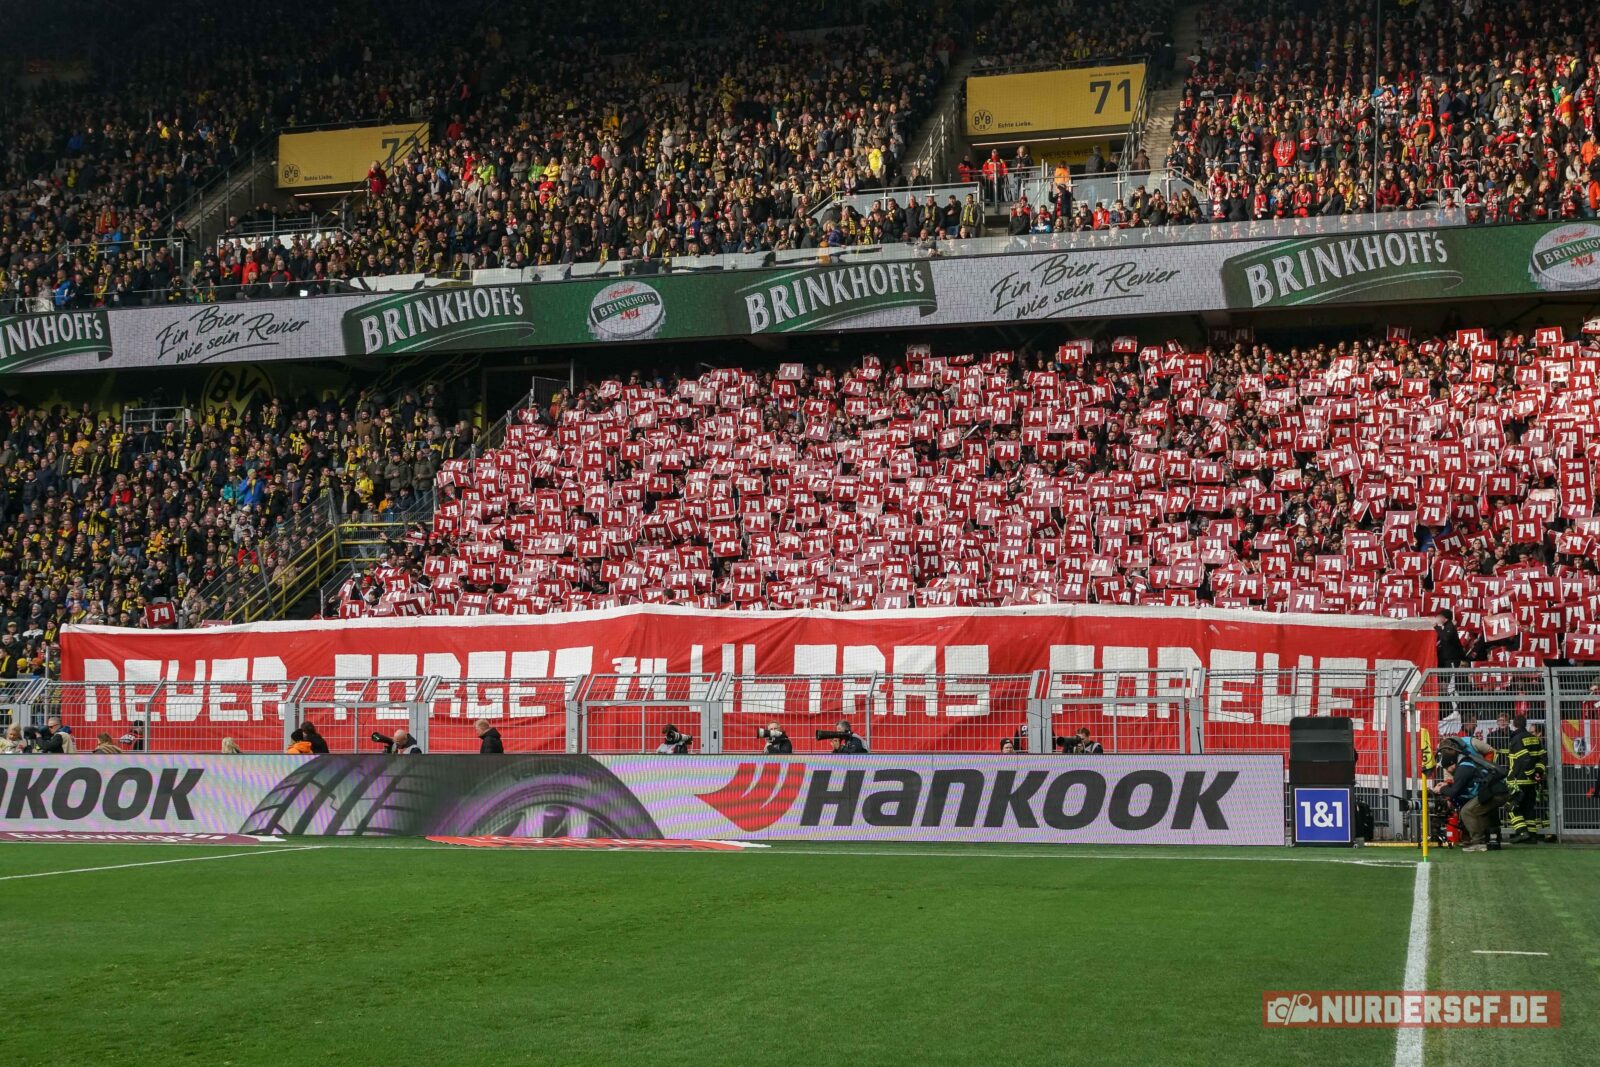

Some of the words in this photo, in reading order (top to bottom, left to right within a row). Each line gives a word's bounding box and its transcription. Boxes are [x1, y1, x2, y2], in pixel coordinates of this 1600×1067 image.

[1089, 79, 1131, 114] 71
[990, 272, 1031, 314] Ein
[1031, 253, 1101, 287] Bier
[1017, 296, 1049, 319] wie
[1053, 279, 1094, 304] sein
[1097, 261, 1180, 294] Revier
[156, 321, 190, 361] Ein
[195, 304, 244, 335] Bier
[176, 343, 204, 363] wie
[206, 328, 240, 351] sein
[242, 313, 311, 344] Revier
[1462, 333, 1478, 345] 74
[1541, 331, 1557, 343] 74
[1065, 349, 1078, 360] 74
[1558, 345, 1574, 358] 74
[1579, 361, 1596, 375] 74
[1040, 376, 1053, 386] 74
[1521, 369, 1537, 381] 74
[849, 382, 862, 393] 74
[1408, 382, 1423, 393] 74
[1574, 376, 1590, 388] 74
[625, 388, 638, 401] 74
[778, 384, 791, 395] 74
[1040, 389, 1054, 400] 74
[724, 395, 737, 406] 74
[810, 402, 823, 412] 74
[955, 410, 969, 421] 74
[1335, 403, 1350, 415] 74
[1029, 411, 1042, 422] 74
[1084, 411, 1098, 421] 74
[1285, 416, 1300, 428] 74
[563, 430, 577, 441] 74
[810, 426, 824, 437] 74
[890, 429, 907, 441] 74
[913, 424, 928, 437] 74
[1275, 431, 1291, 443] 74
[605, 432, 618, 443] 74
[1301, 436, 1317, 448] 74
[1483, 437, 1499, 450] 74
[626, 445, 639, 456] 74
[712, 444, 726, 455] 74
[999, 444, 1015, 456] 74
[1042, 444, 1057, 456] 74
[1506, 446, 1524, 462] 74
[499, 455, 511, 465] 74
[588, 453, 601, 464] 74
[665, 452, 678, 465] 74
[1239, 451, 1255, 465] 74
[1272, 451, 1287, 464] 74
[1444, 457, 1461, 470] 74
[1169, 463, 1185, 476] 74
[1201, 465, 1217, 478] 74
[1408, 459, 1425, 472] 74
[482, 469, 495, 479] 74
[584, 471, 596, 482] 74
[868, 471, 883, 483] 74
[1138, 473, 1155, 486] 74
[1566, 472, 1584, 485] 74
[653, 477, 667, 488] 74
[1429, 478, 1447, 492] 74
[1458, 477, 1475, 491] 74
[1493, 478, 1510, 491] 74
[482, 483, 496, 497] 74
[566, 491, 579, 502] 74
[838, 485, 854, 497] 74
[888, 486, 904, 499] 74
[1093, 486, 1108, 498] 74
[1391, 486, 1409, 499] 74
[1567, 487, 1586, 502] 74
[591, 497, 604, 509] 74
[955, 493, 970, 507] 74
[1038, 491, 1054, 504] 74
[1259, 497, 1275, 510] 74
[1068, 499, 1083, 512] 74
[1134, 503, 1151, 515] 74
[1457, 505, 1474, 518] 74
[1528, 504, 1547, 519] 74
[547, 515, 561, 526] 74
[607, 511, 622, 523] 74
[1423, 507, 1440, 521] 74
[439, 519, 452, 531] 74
[510, 523, 525, 538] 74
[675, 520, 692, 534] 74
[1006, 525, 1022, 536] 74
[1103, 519, 1119, 532] 74
[1215, 523, 1232, 540] 74
[1516, 523, 1535, 538] 74
[715, 526, 730, 538] 74
[917, 529, 933, 542] 74
[1389, 528, 1408, 542] 74
[582, 541, 596, 553] 74
[1071, 534, 1086, 547] 74
[1441, 535, 1462, 551] 74
[1040, 543, 1055, 558] 74
[923, 555, 938, 569] 74
[1063, 557, 1080, 570] 74
[1359, 551, 1378, 565] 74
[1402, 556, 1421, 572] 74
[429, 559, 444, 573] 74
[1267, 557, 1286, 573] 74
[1323, 559, 1341, 572] 74
[472, 568, 486, 580] 74
[671, 573, 686, 585] 74
[1176, 570, 1193, 583] 74
[1292, 566, 1309, 580] 74
[621, 577, 637, 590] 74
[737, 583, 754, 597] 74
[855, 583, 873, 597] 74
[995, 579, 1013, 593] 74
[1238, 579, 1257, 594] 74
[1272, 581, 1291, 597] 74
[1348, 586, 1367, 600] 74
[1296, 594, 1315, 610] 74
[152, 607, 170, 622] 74
[152, 606, 172, 624] 74
[1461, 612, 1481, 628] 74
[1540, 612, 1560, 628] 74
[1566, 606, 1585, 622] 74
[1529, 638, 1550, 653] 74
[1573, 638, 1595, 654] 74
[333, 646, 594, 721] FORGET
[689, 643, 990, 717] ULTRAS
[1300, 801, 1343, 828] 1&1
